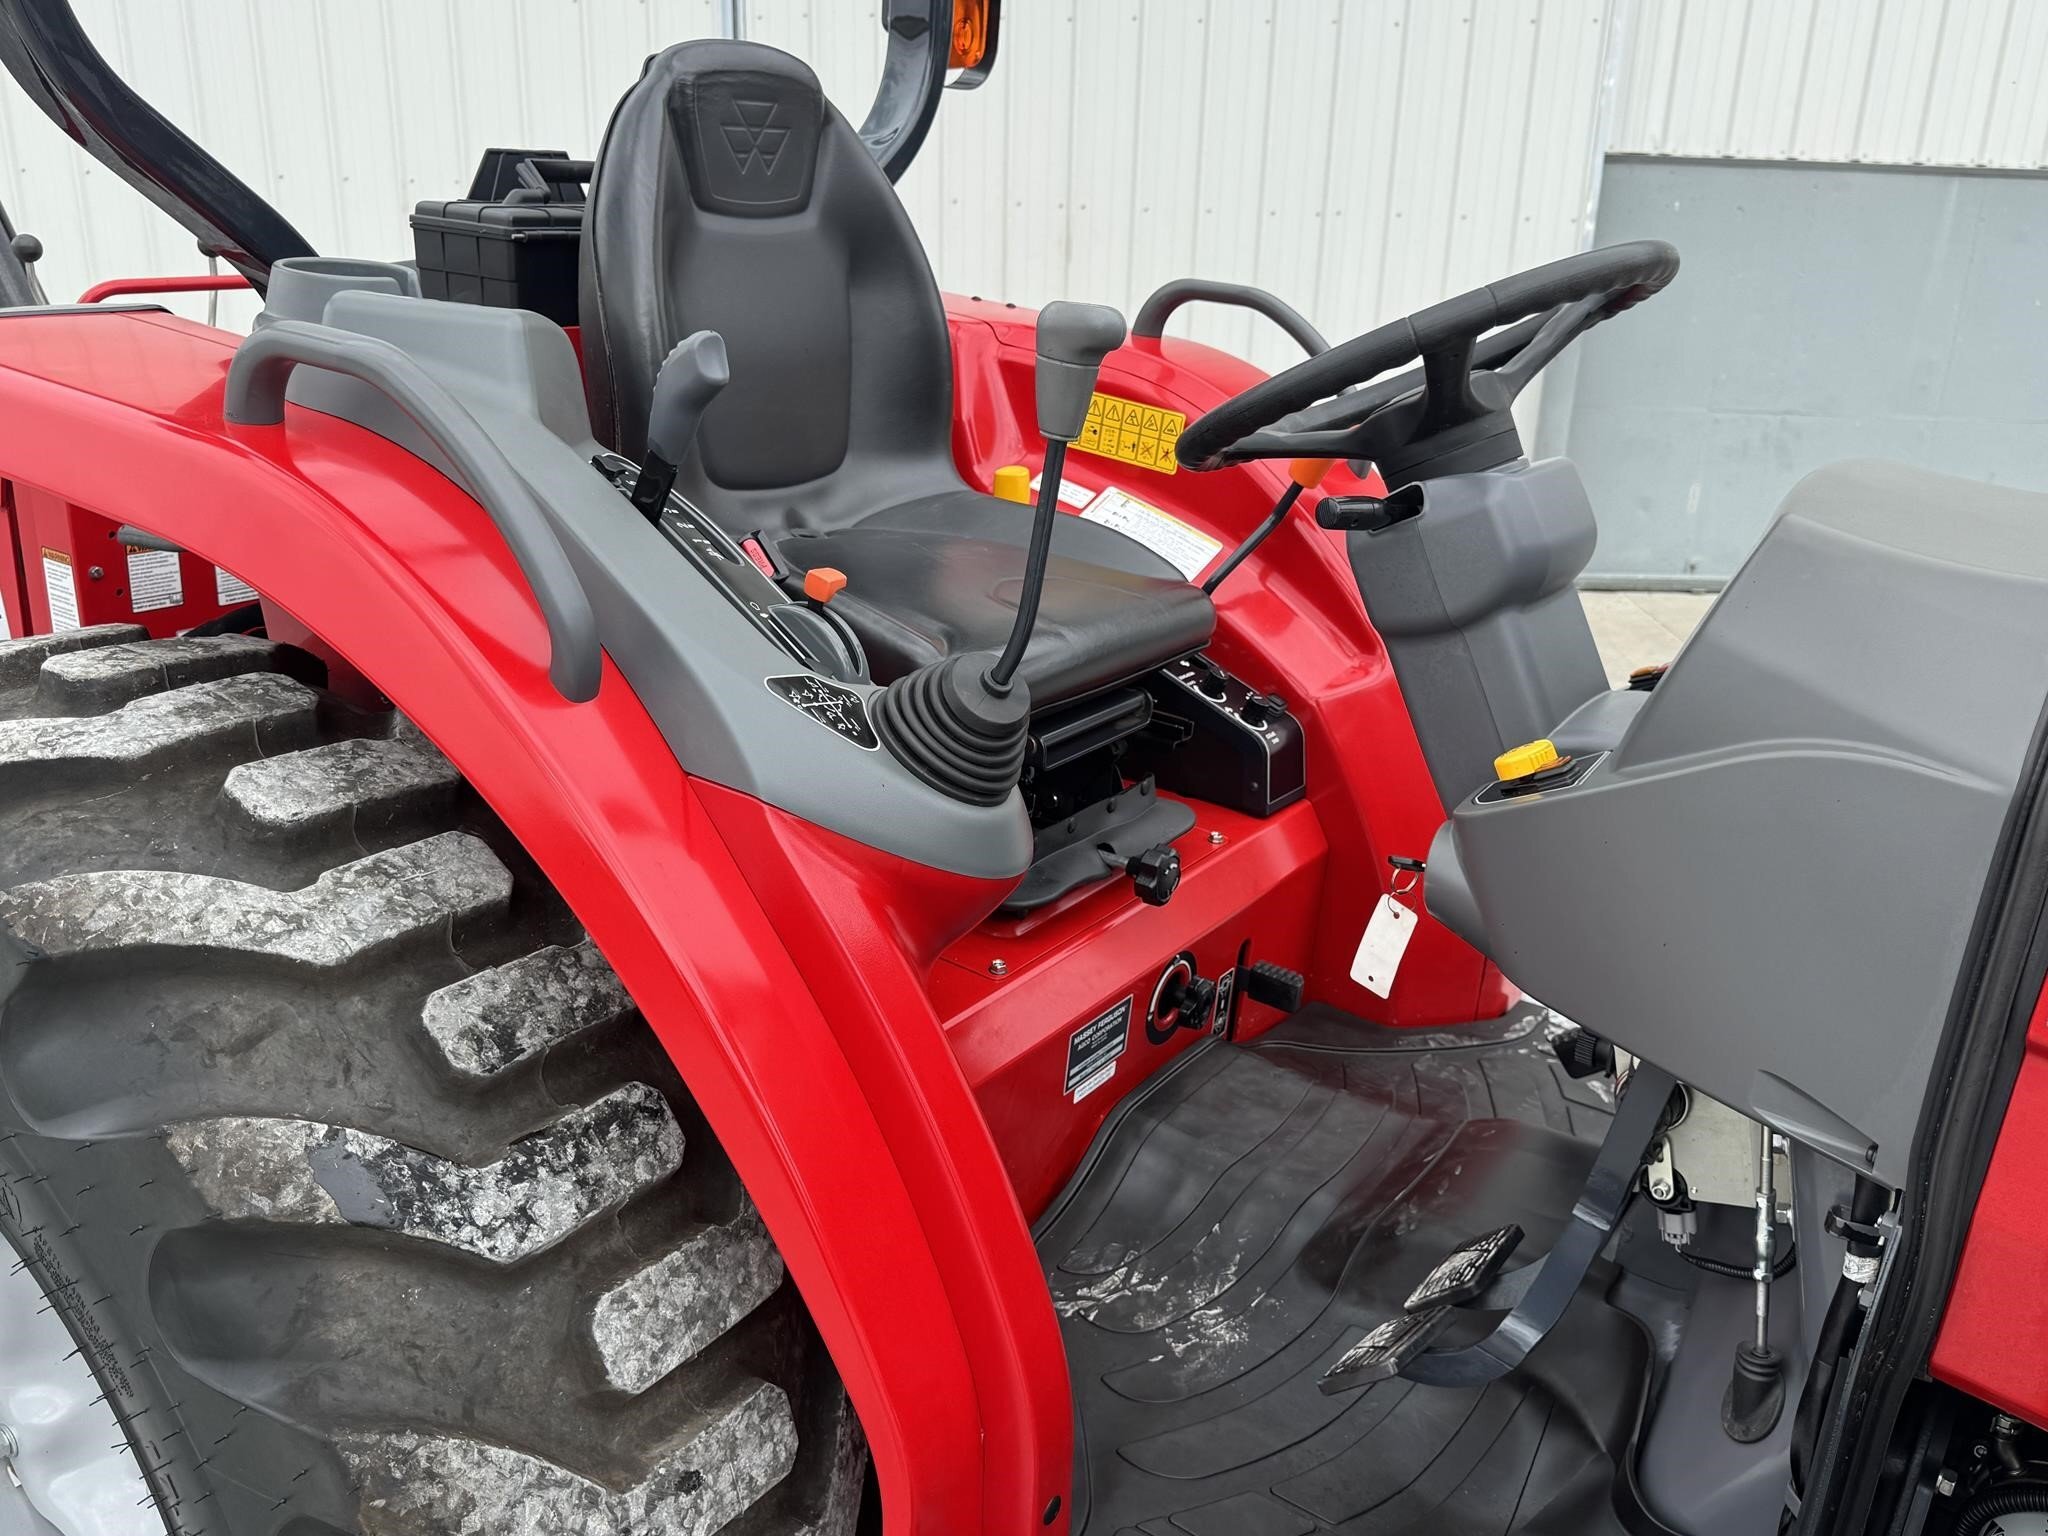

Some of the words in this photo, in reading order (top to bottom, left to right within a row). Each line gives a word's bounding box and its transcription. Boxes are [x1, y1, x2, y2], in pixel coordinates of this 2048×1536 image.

[1074, 1023, 1098, 1046] MASSEY
[1097, 1006, 1126, 1031] FERGUSON
[1091, 1016, 1123, 1041] CORPORATION
